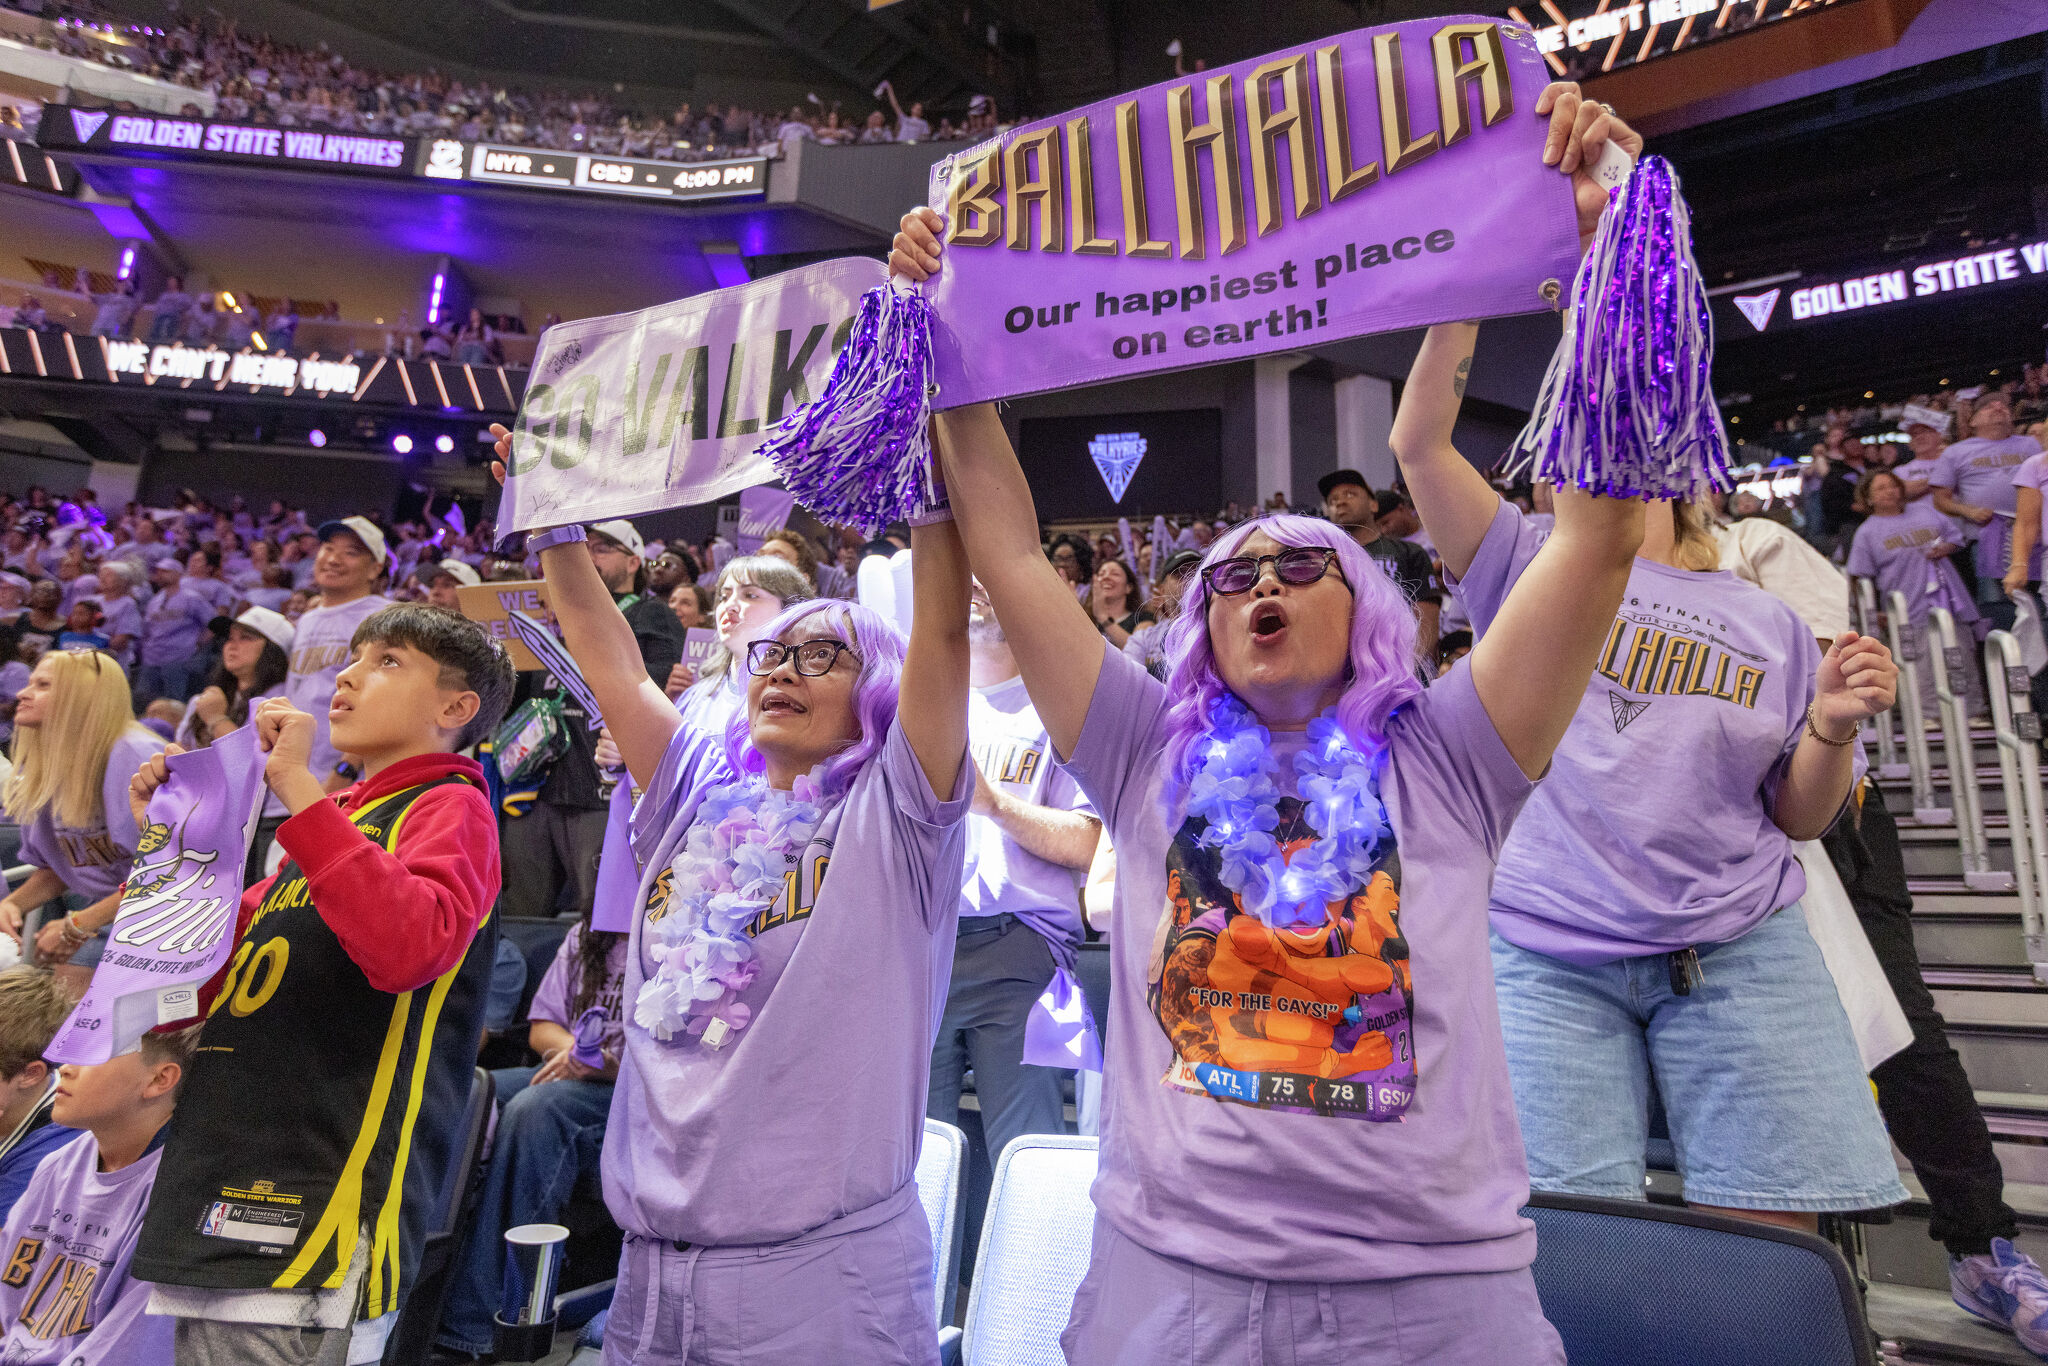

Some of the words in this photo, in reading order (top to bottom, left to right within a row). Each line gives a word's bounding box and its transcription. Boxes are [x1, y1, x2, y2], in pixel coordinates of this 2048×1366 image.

[109, 116, 203, 150] GOLDEN
[204, 124, 282, 157] STATE
[284, 131, 404, 167] VALKYRIES
[945, 21, 1515, 261] BALLHALLA
[486, 152, 532, 174] NYR
[590, 163, 634, 183] CBJ
[673, 168, 721, 189] 4:00
[723, 165, 754, 184] PM
[1003, 300, 1081, 334] Our
[1095, 259, 1299, 318] happiest
[1314, 226, 1457, 287] place
[1790, 269, 1908, 320] GOLDEN
[1912, 247, 2020, 297] STATE
[1112, 330, 1168, 360] on
[1183, 298, 1329, 349] earth!
[107, 340, 150, 374] WE
[507, 373, 601, 478] GO
[497, 589, 541, 612] WE
[1652, 602, 1728, 632] FINALS
[1632, 614, 1660, 625] THIS
[114, 953, 154, 970] GOLDEN
[150, 960, 182, 975] STATE
[1238, 993, 1272, 1011] THE
[1366, 1009, 1400, 1031] GOLDEN
[1207, 1068, 1242, 1091] ATL
[1271, 1076, 1295, 1096] 75
[1329, 1084, 1355, 1101] 78
[1379, 1087, 1411, 1107] GSV
[221, 1190, 247, 1200] GOLDEN
[246, 1194, 266, 1202] STATE
[266, 1196, 302, 1205] WARRIORS
[232, 1209, 242, 1218] M
